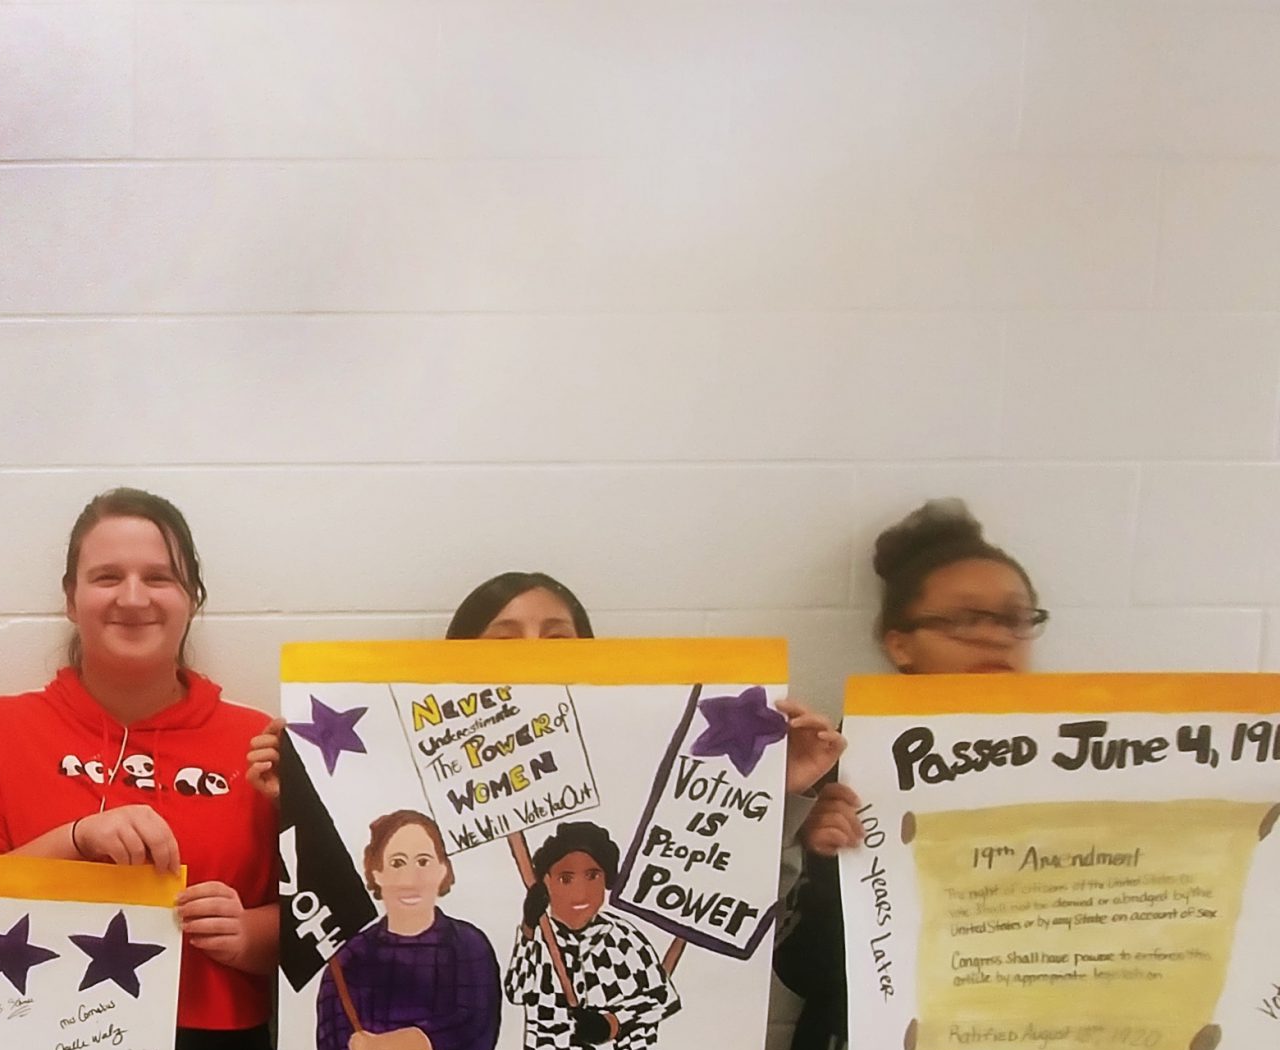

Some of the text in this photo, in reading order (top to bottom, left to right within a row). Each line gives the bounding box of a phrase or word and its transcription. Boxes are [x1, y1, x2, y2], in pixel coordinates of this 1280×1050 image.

[553, 702, 570, 733] of
[1176, 724, 1219, 769] 4,
[447, 751, 558, 815] WOMEN
[686, 812, 729, 837] IS
[856, 803, 886, 849] 100
[973, 844, 1144, 872] 19th Amendment
